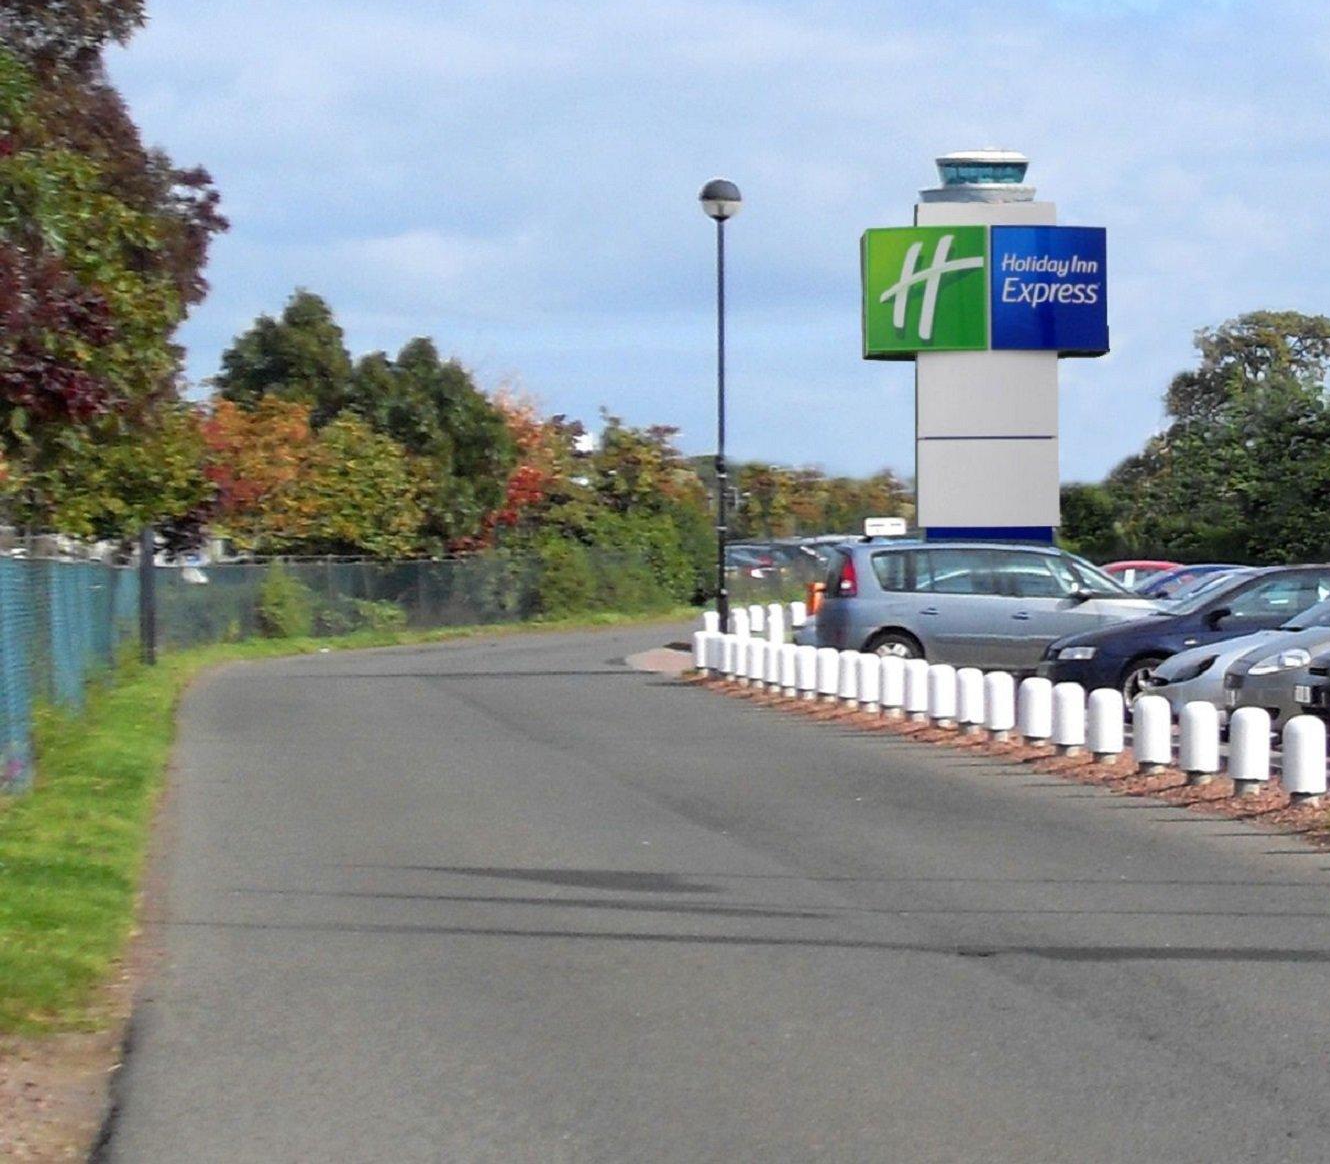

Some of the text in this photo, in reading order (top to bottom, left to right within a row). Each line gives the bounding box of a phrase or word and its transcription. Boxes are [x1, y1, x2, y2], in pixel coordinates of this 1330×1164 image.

[1002, 253, 1098, 277] Holiday Inn
[1002, 277, 1099, 308] Express
